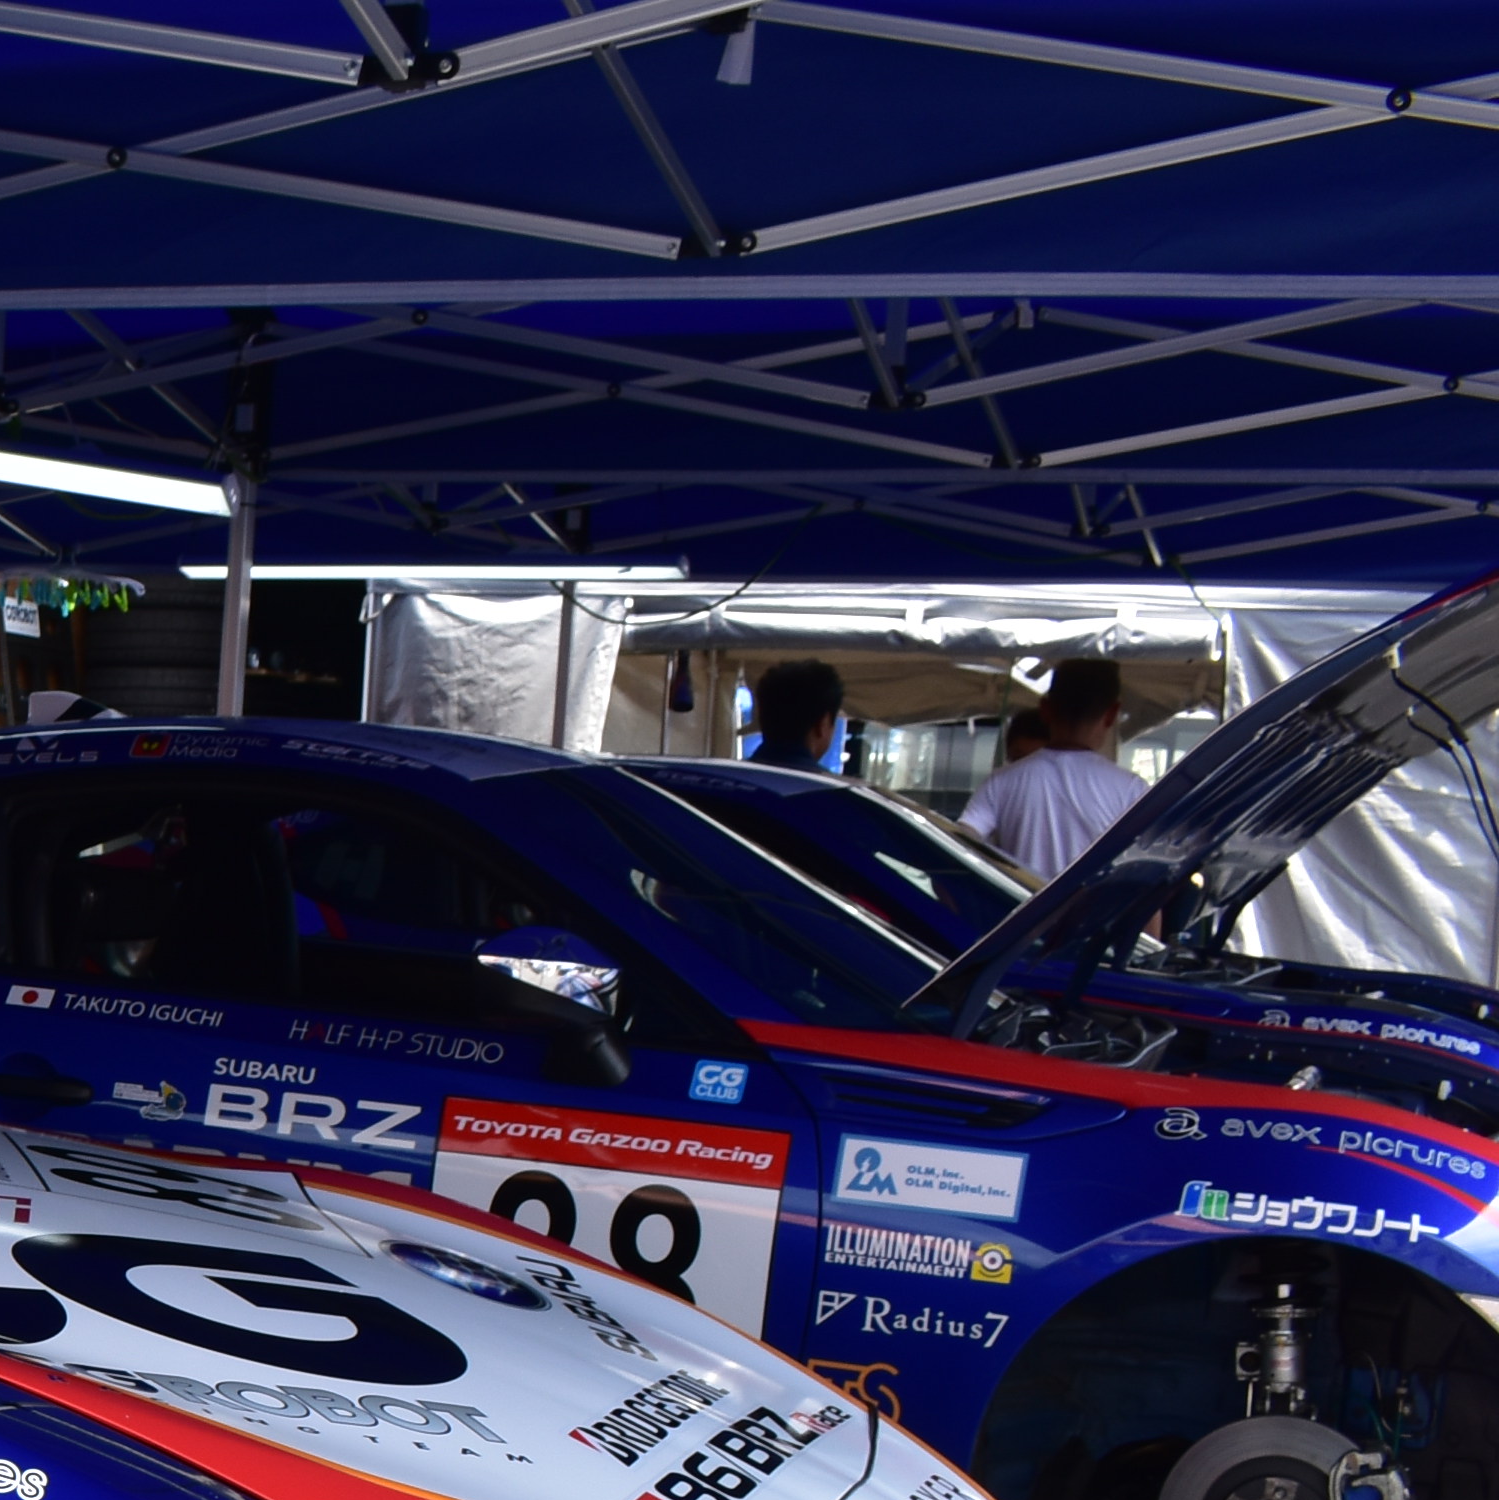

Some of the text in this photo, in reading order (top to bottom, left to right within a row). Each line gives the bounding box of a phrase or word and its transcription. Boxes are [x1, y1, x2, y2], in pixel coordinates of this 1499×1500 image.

[168, 745, 239, 760] Media
[63, 992, 225, 1028] TAKUTO IGUCHI
[405, 1032, 505, 1065] STUDIO
[213, 1057, 316, 1085] SUBARU
[696, 1065, 745, 1087] CG
[694, 1083, 740, 1101] CLUB
[204, 1083, 423, 1150] BRZ
[1220, 1115, 1322, 1147] avex
[453, 1115, 775, 1171] TOYOTA GAZOO Racing
[1228, 1191, 1440, 1244] ショウワノート
[826, 1224, 971, 1269] ILLUMINATION
[824, 1252, 968, 1279] ENTERTAINMENT
[861, 1296, 1010, 1348] Radius7
[570, 1369, 731, 1467] BRIDGESTONE
